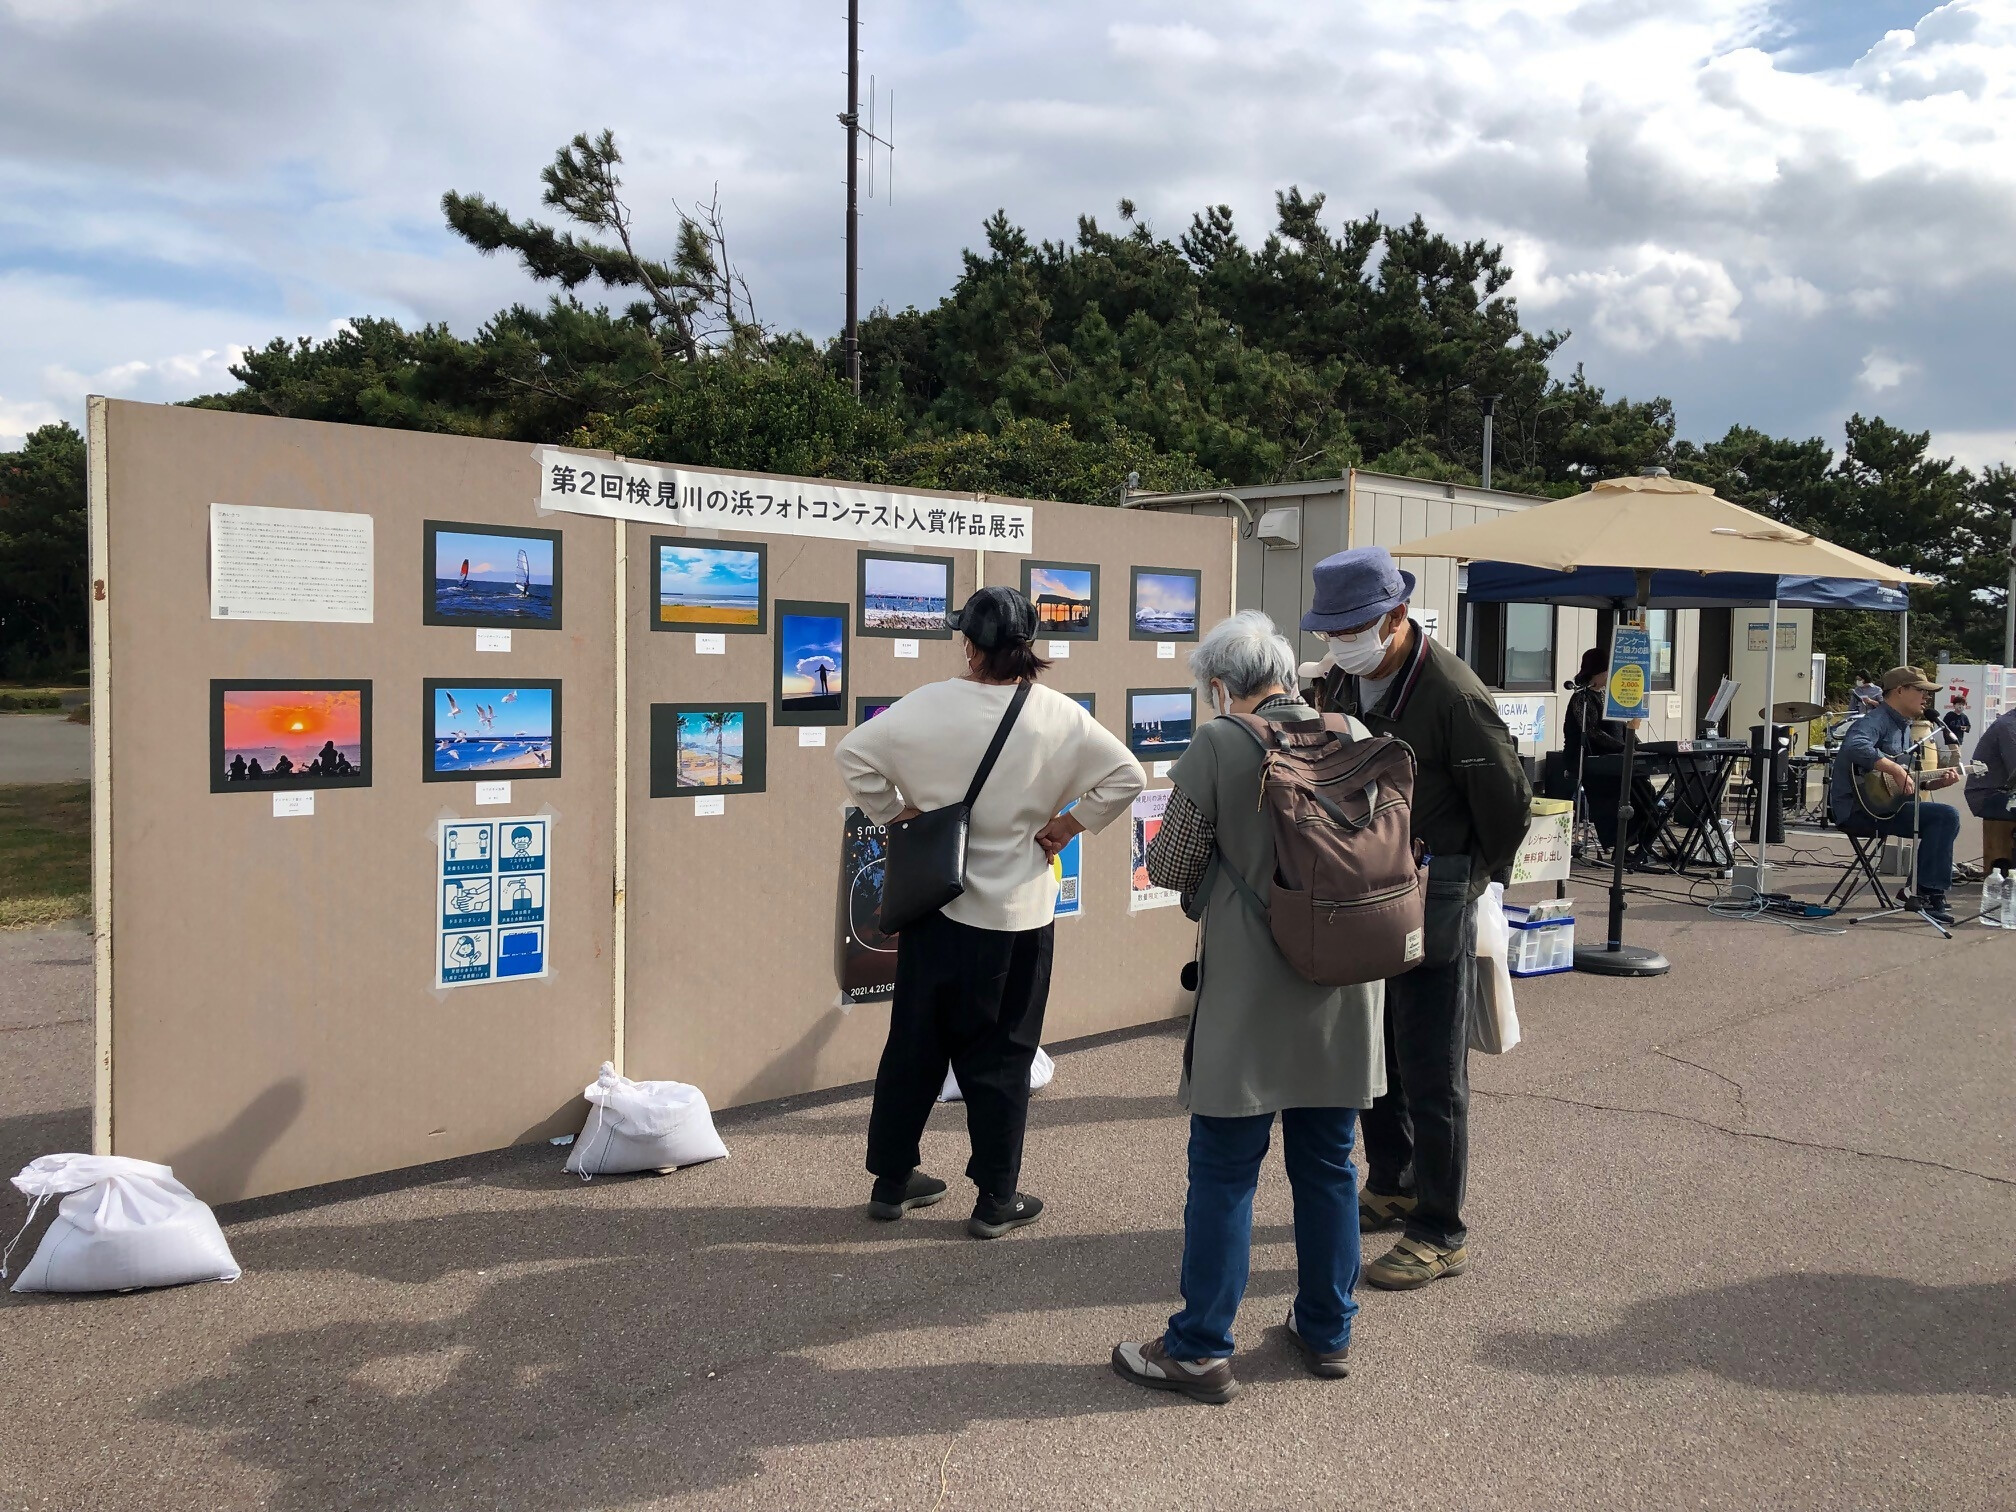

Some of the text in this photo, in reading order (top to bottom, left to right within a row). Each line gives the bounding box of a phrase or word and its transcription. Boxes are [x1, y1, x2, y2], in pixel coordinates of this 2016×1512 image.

[550, 463, 1026, 540] 第2回検見川の浜フォトコンテスト入賞作品展示
[1153, 803, 1168, 811] 202
[1527, 832, 1563, 846] レジャーシート
[1523, 850, 1563, 865] 無料貸し出し
[850, 984, 886, 997] 2021.4.22
